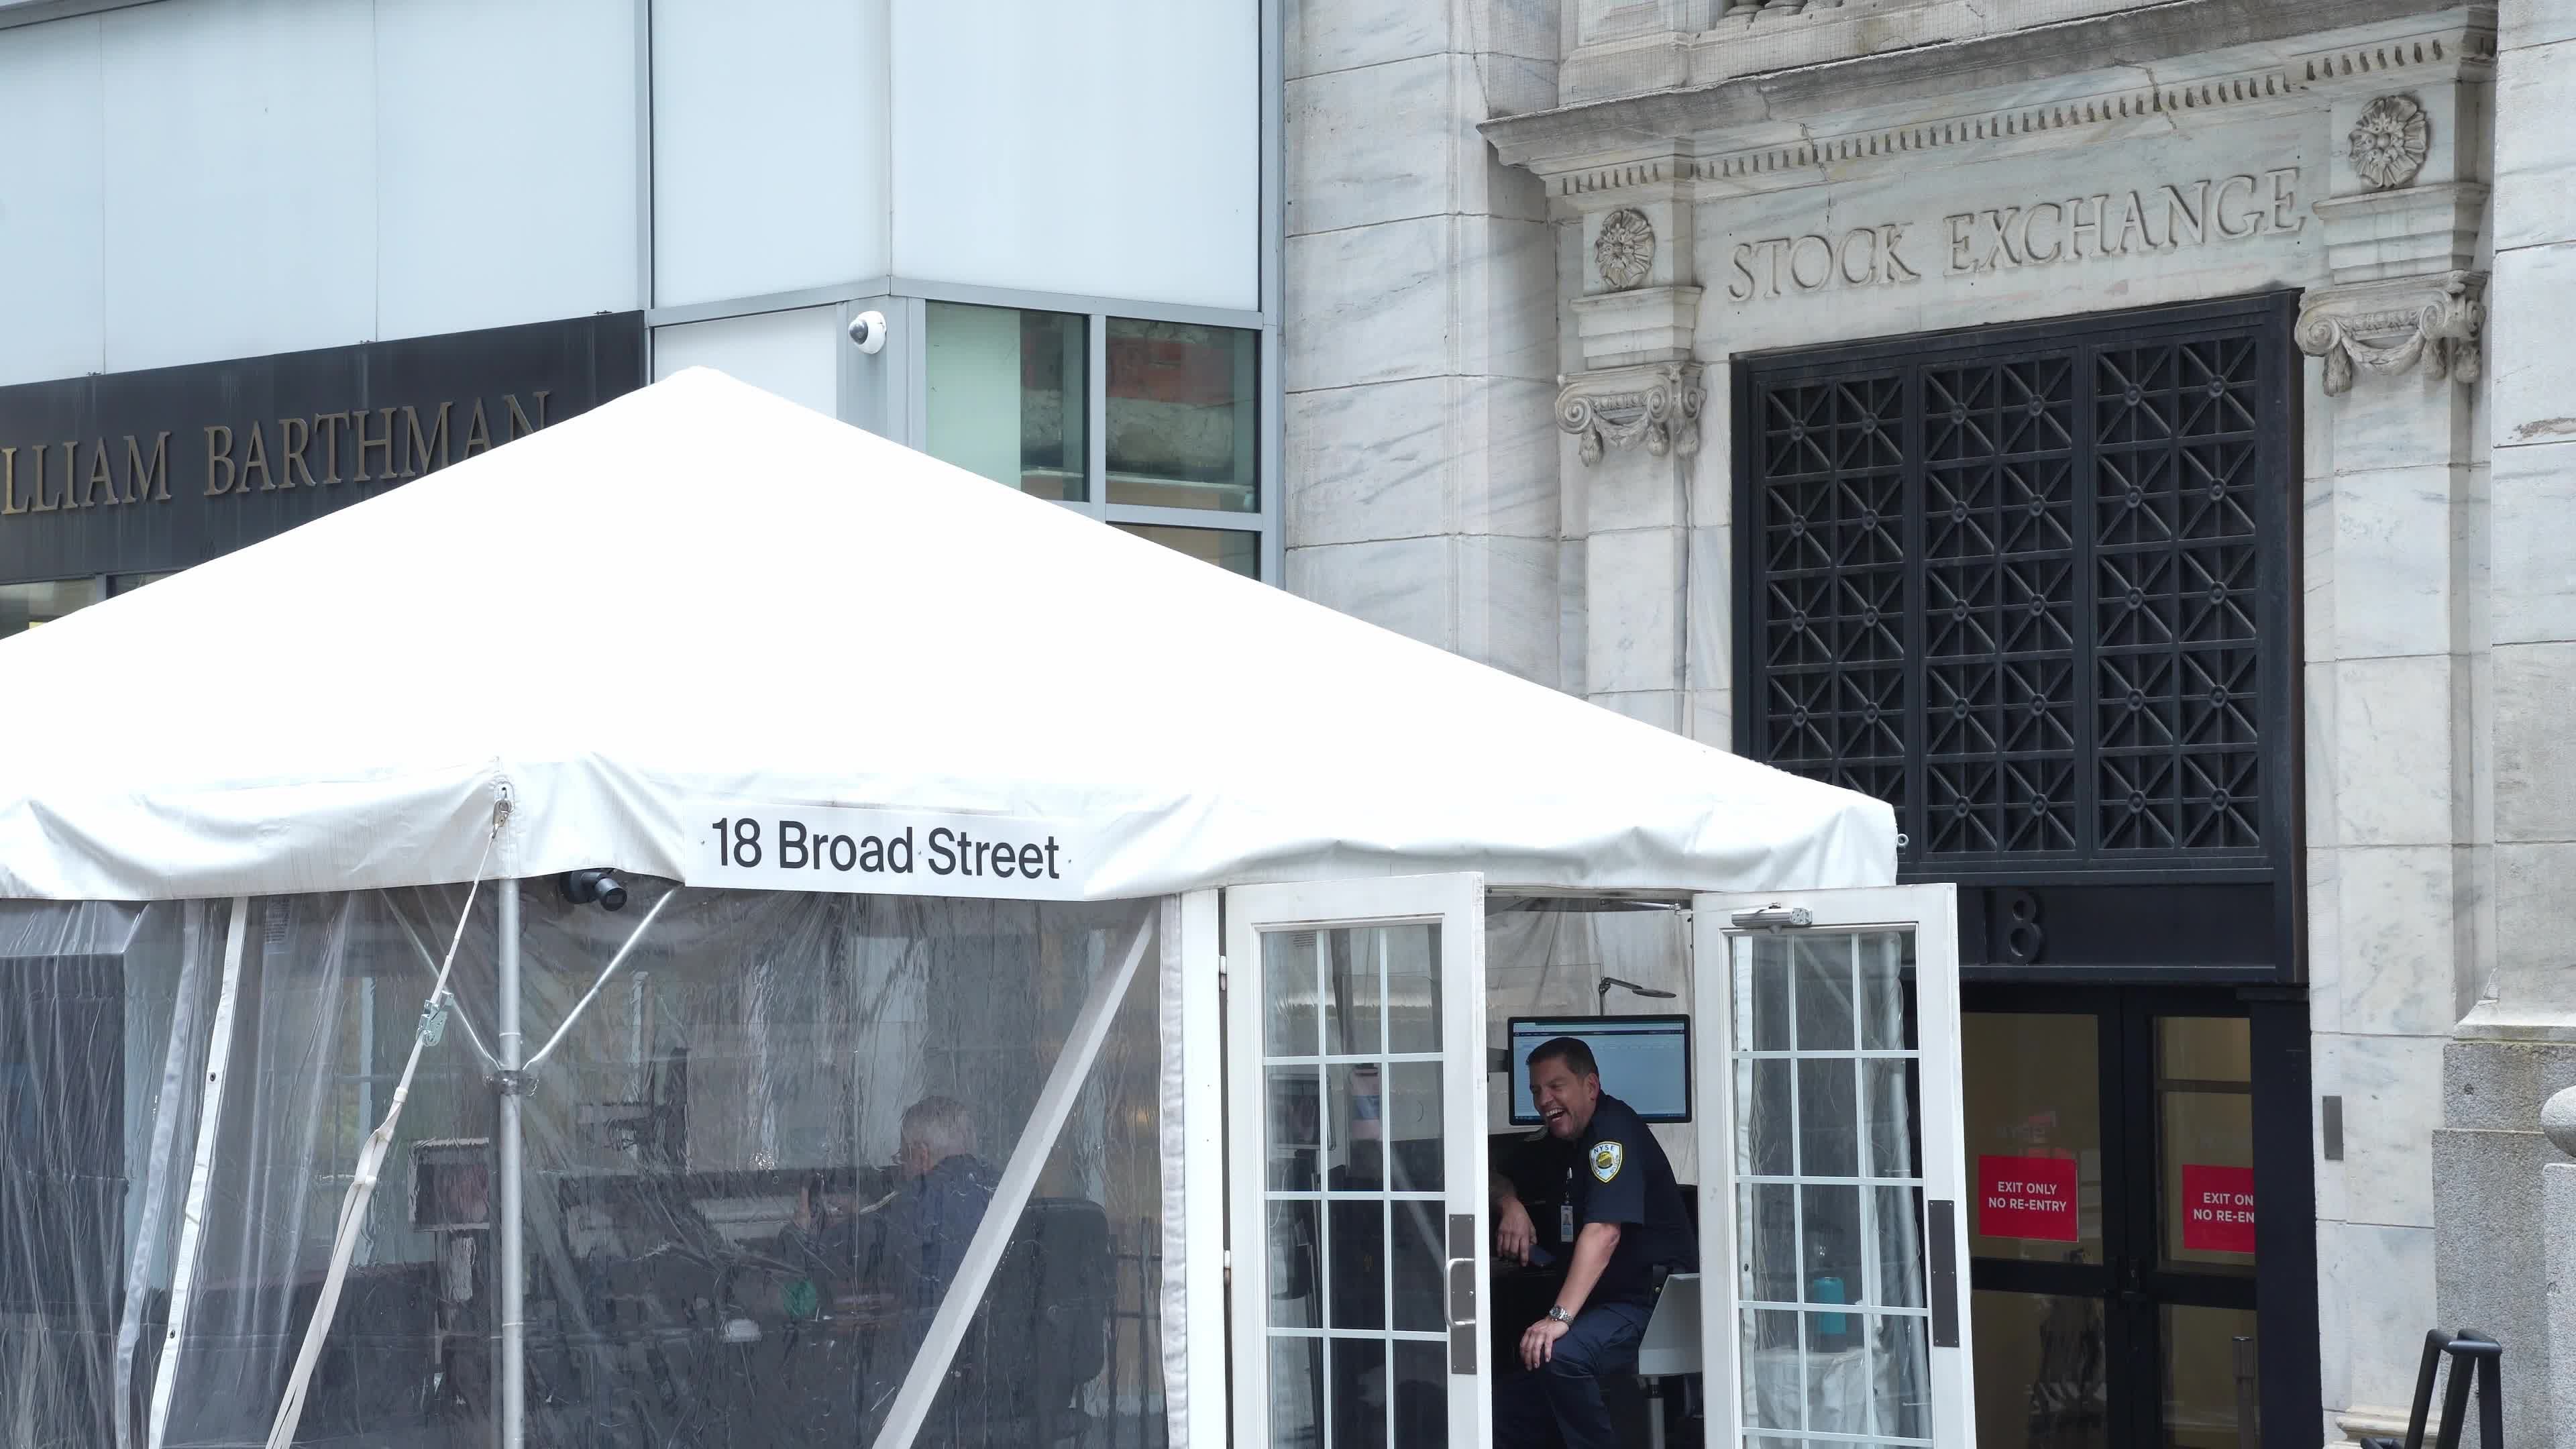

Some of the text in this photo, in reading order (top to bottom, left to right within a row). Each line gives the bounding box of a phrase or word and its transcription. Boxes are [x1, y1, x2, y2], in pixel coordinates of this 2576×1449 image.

[1728, 166, 2306, 302] STOCK EXCHANGE
[203, 390, 551, 497] BARTHMAN
[712, 817, 1060, 879] 18 Broad Street
[1973, 890, 2041, 963] 18
[1594, 1144, 1615, 1154] NYSE
[1998, 1181, 2057, 1195] EXIT ONLY
[1988, 1197, 2067, 1212] NO RE-ENTRY
[2203, 1191, 2231, 1204] EXIT
[2193, 1208, 2212, 1220] NO
